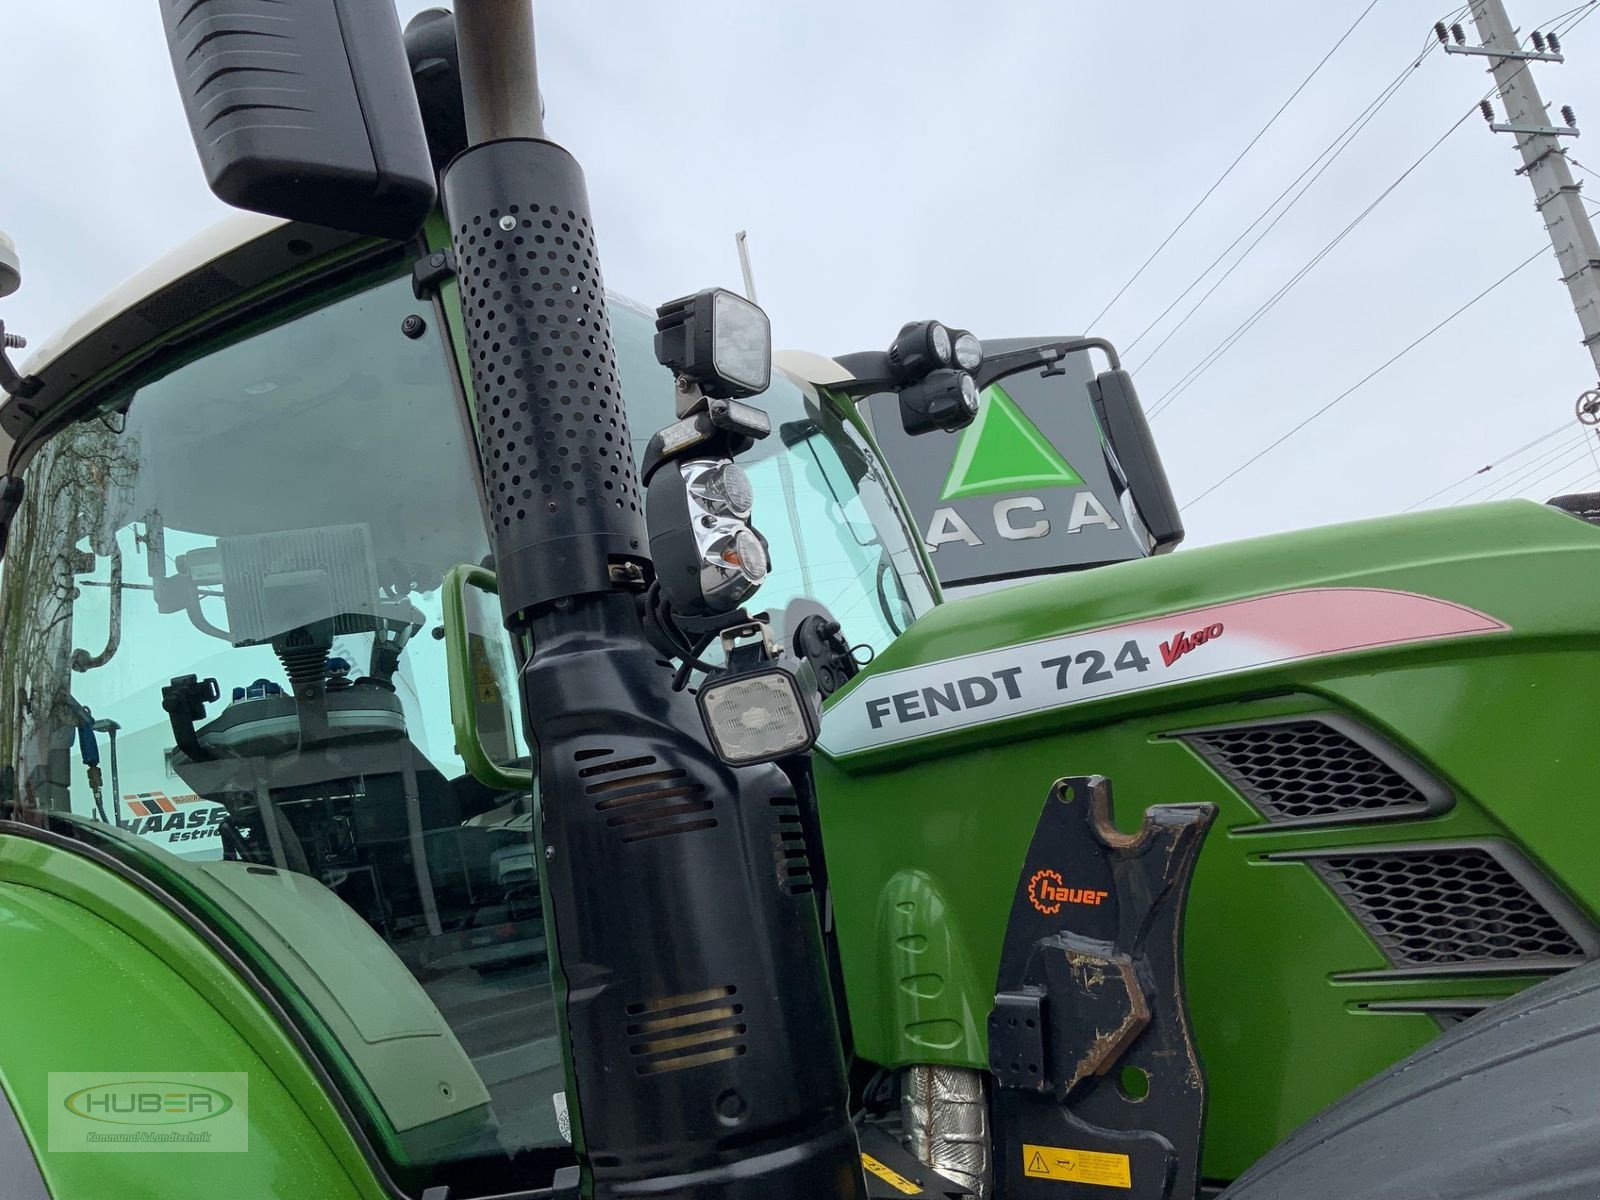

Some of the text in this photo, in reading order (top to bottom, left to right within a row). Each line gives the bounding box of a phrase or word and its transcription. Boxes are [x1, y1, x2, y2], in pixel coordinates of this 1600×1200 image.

[924, 491, 1121, 553] ACA
[865, 667, 1022, 729] FENDT
[1041, 640, 1150, 690] 724
[1041, 880, 1108, 905] hauer
